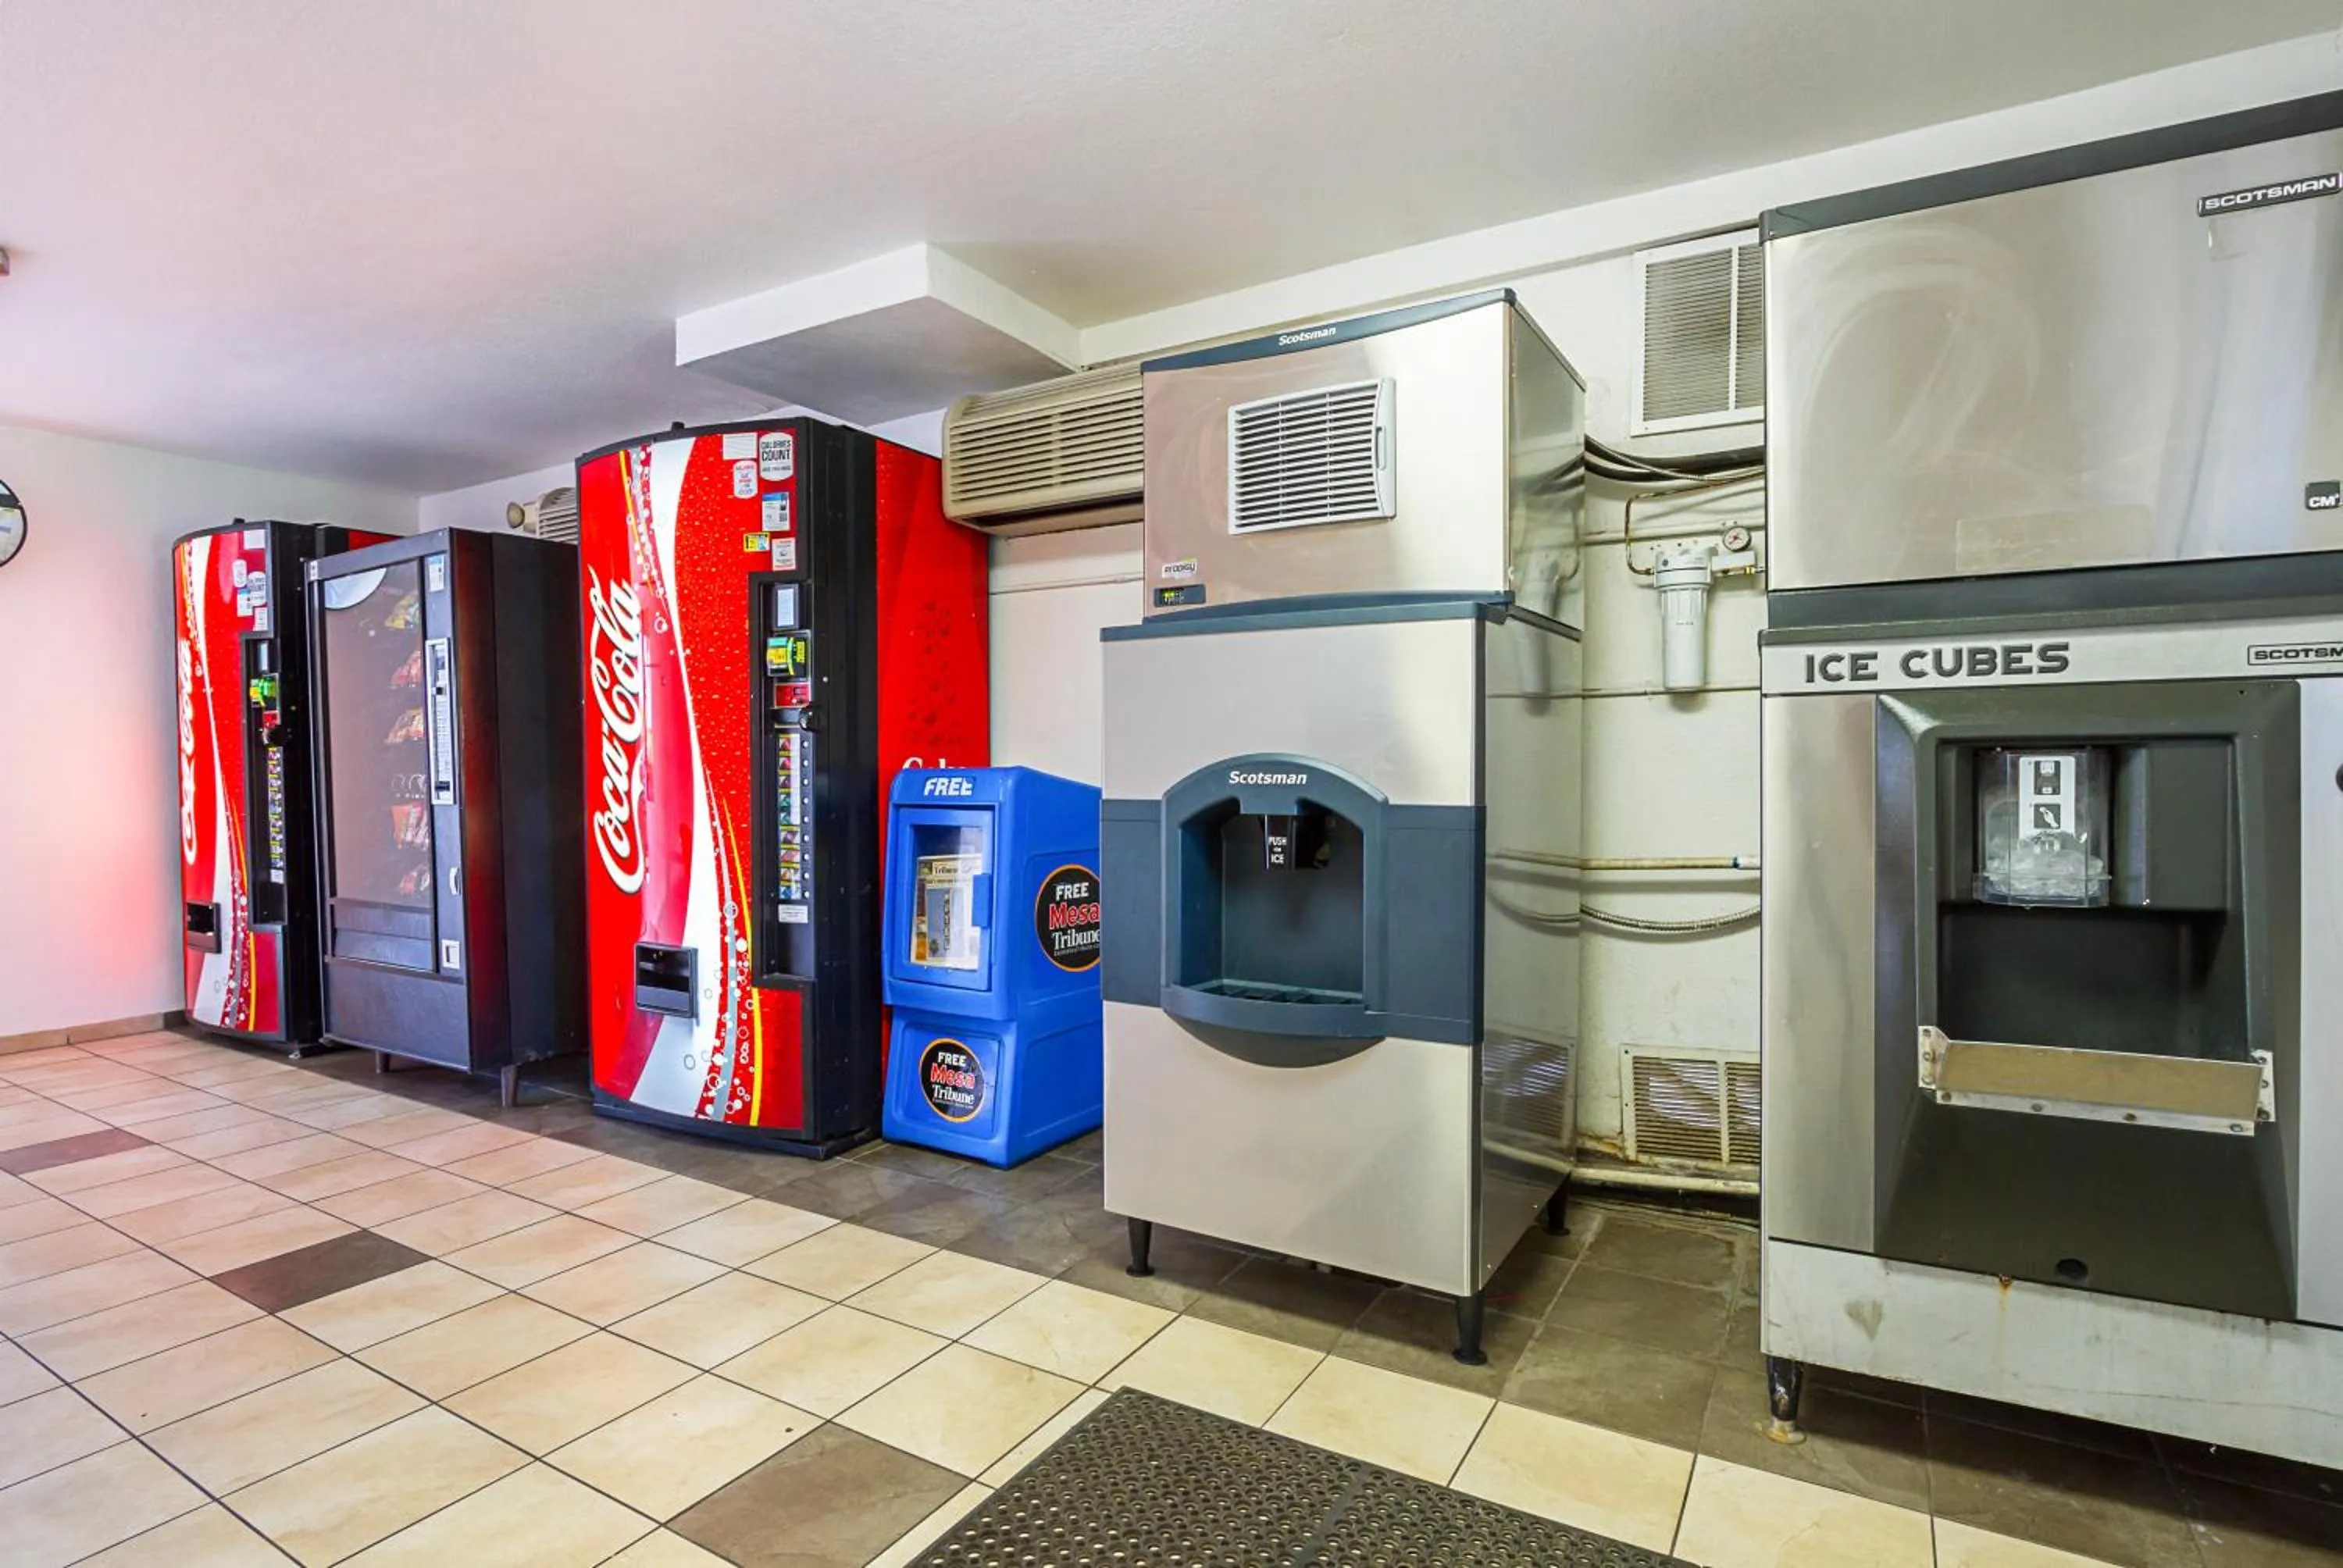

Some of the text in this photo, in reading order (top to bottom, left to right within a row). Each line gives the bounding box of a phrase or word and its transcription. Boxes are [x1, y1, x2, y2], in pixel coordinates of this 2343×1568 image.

[2204, 176, 2337, 210] SCOTSMAN
[1278, 326, 1336, 346] Scotsman
[761, 450, 790, 461] COUNT
[1805, 641, 2070, 683] ICE CUBES
[923, 777, 973, 796] FREE
[1229, 770, 1308, 785] Scotsman
[1268, 836, 1288, 846] PUSH
[1271, 853, 1285, 864] ICE
[1055, 882, 1089, 901] FREE
[1049, 901, 1100, 930] Mesa
[938, 1051, 967, 1067] FREE
[930, 1062, 975, 1089] Mesa
[932, 1084, 975, 1104] Tribune
